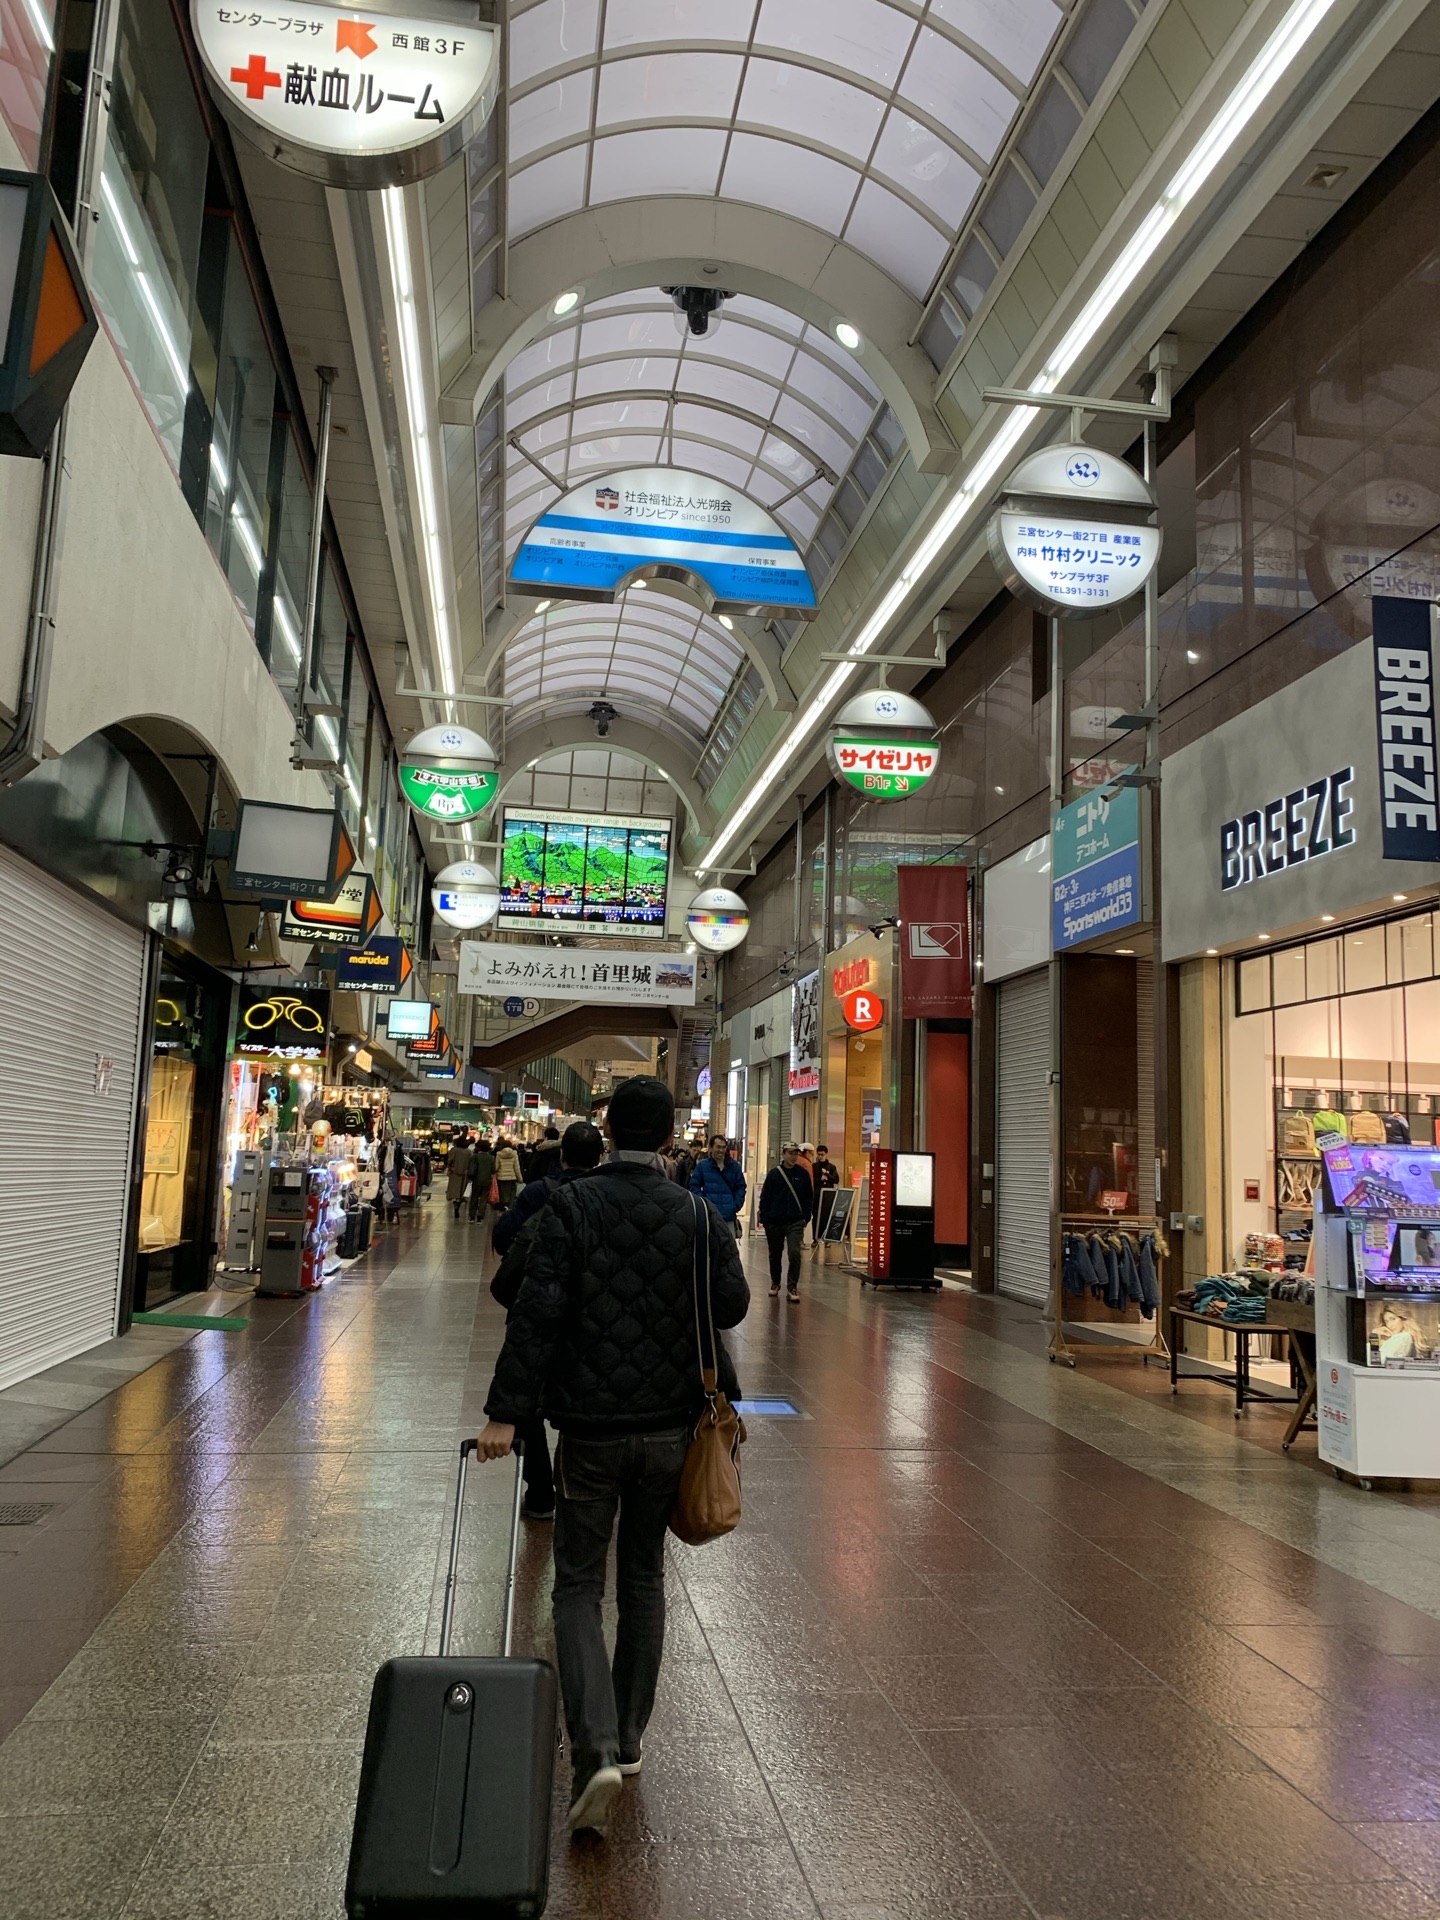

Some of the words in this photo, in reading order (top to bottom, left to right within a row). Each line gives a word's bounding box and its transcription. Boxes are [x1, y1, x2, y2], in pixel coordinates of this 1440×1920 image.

[216, 8, 324, 36] センタープラザ
[284, 63, 446, 123] 献血ルーム
[624, 490, 733, 512] 社会福祉法人光朔会
[624, 505, 679, 520] オリンピア
[681, 512, 731, 524] since1950
[1017, 526, 1108, 543] 三宮センター街2丁目
[1113, 533, 1141, 546] 産業医
[748, 557, 777, 567] 保育事業
[1017, 546, 1037, 558] 内科
[1041, 545, 1142, 567] 竹村クリニック
[1049, 569, 1110, 584] サンプラザ3F
[1048, 585, 1110, 597] TEL391-3131
[1377, 646, 1438, 832] BREEZE
[840, 748, 932, 772] サイゼリヤ
[864, 774, 891, 790] B1F
[514, 811, 545, 820] Downtown
[561, 813, 574, 822] with
[575, 815, 601, 824] mountain
[603, 818, 620, 827] range
[628, 819, 662, 829] background
[1055, 817, 1065, 832] 4F
[1076, 796, 1110, 838] ニトリ
[1221, 766, 1356, 892] BREEZE
[1076, 833, 1110, 863] デコホーム
[236, 877, 326, 894] 三宮センター街2丁目
[1063, 891, 1132, 940] Sportsworld33
[284, 926, 359, 943] 三宮センター街2丁目
[348, 955, 390, 966] marudai
[338, 982, 396, 991] 三宮センター街2丁目
[526, 1001, 535, 1010] D
[855, 997, 873, 1018] R
[268, 1045, 321, 1060] 大学堂
[878, 1226, 886, 1268] DIAMOND
